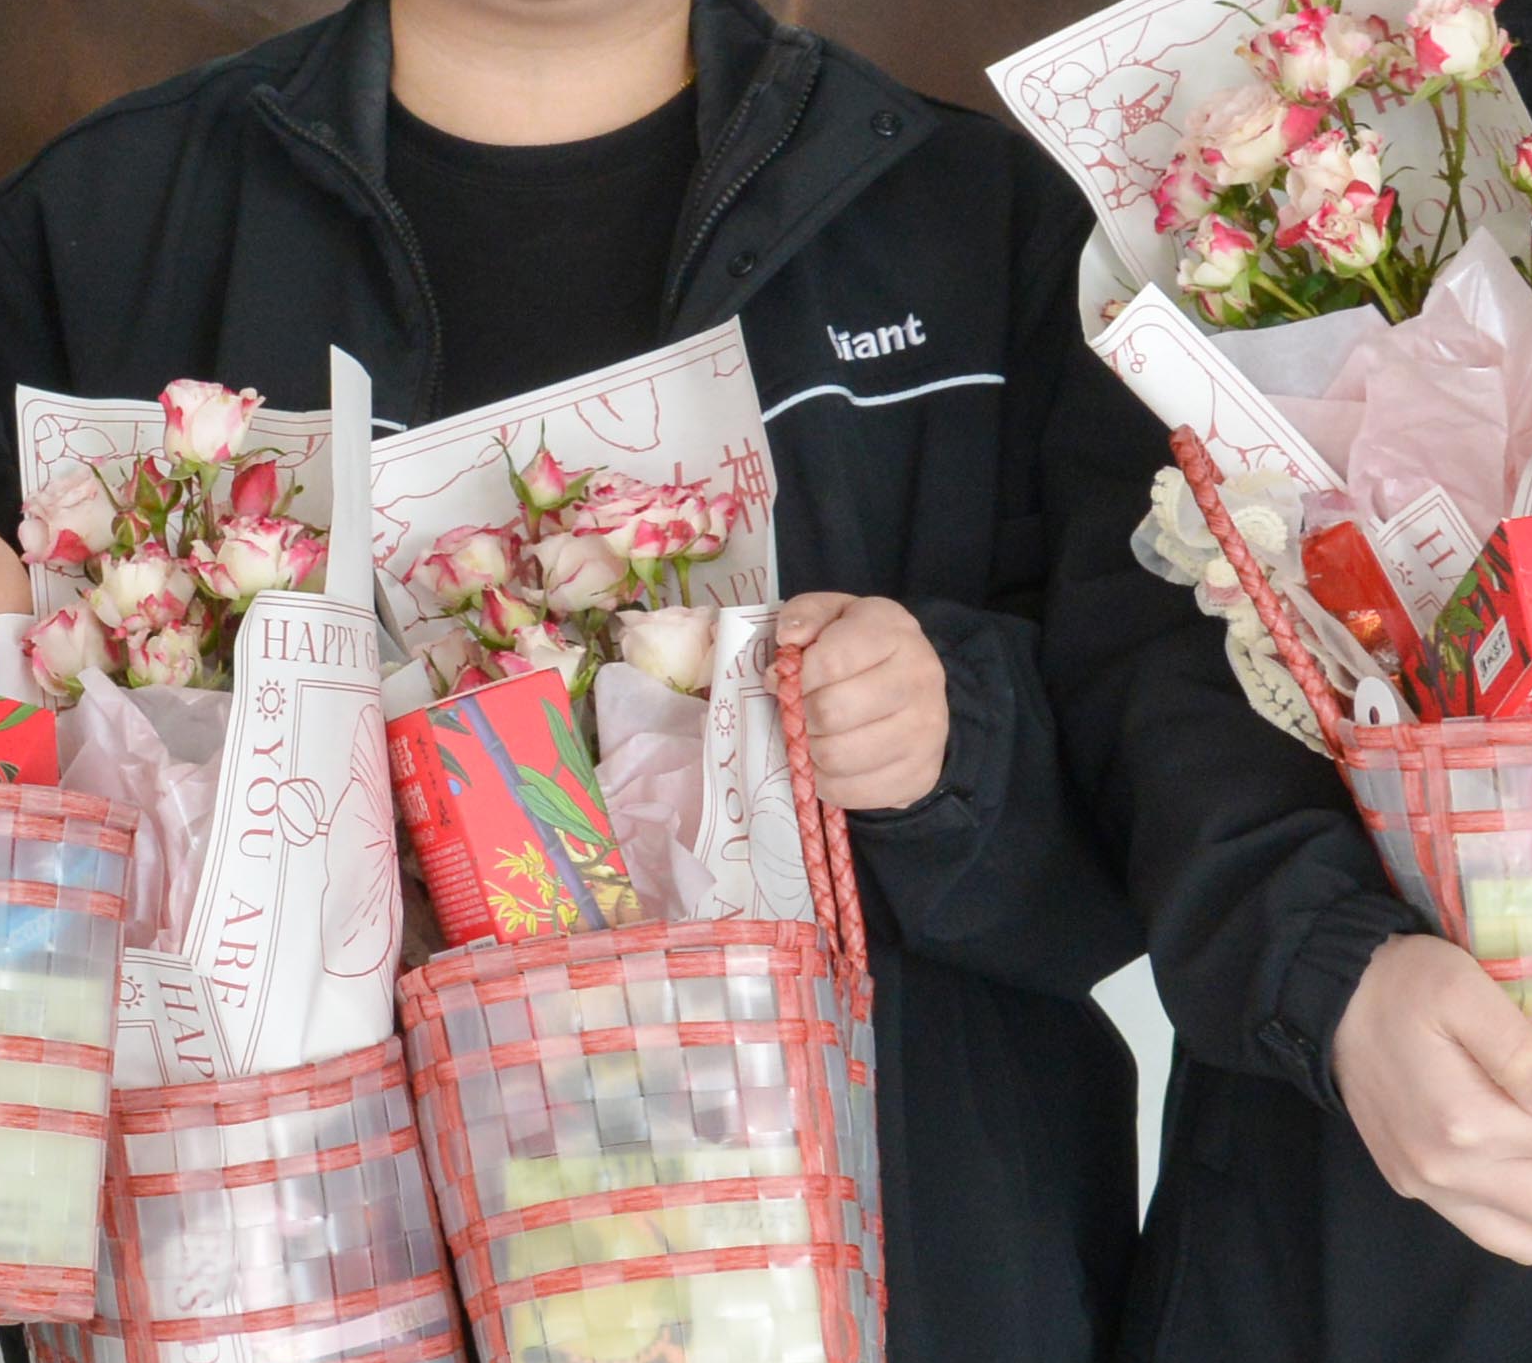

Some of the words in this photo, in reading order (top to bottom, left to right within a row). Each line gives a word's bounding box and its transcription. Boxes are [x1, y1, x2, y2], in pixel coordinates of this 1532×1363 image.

[261, 618, 359, 669] HAPPY
[237, 737, 285, 862] YOU
[718, 750, 751, 863] YOU
[158, 979, 216, 1079] HAP
